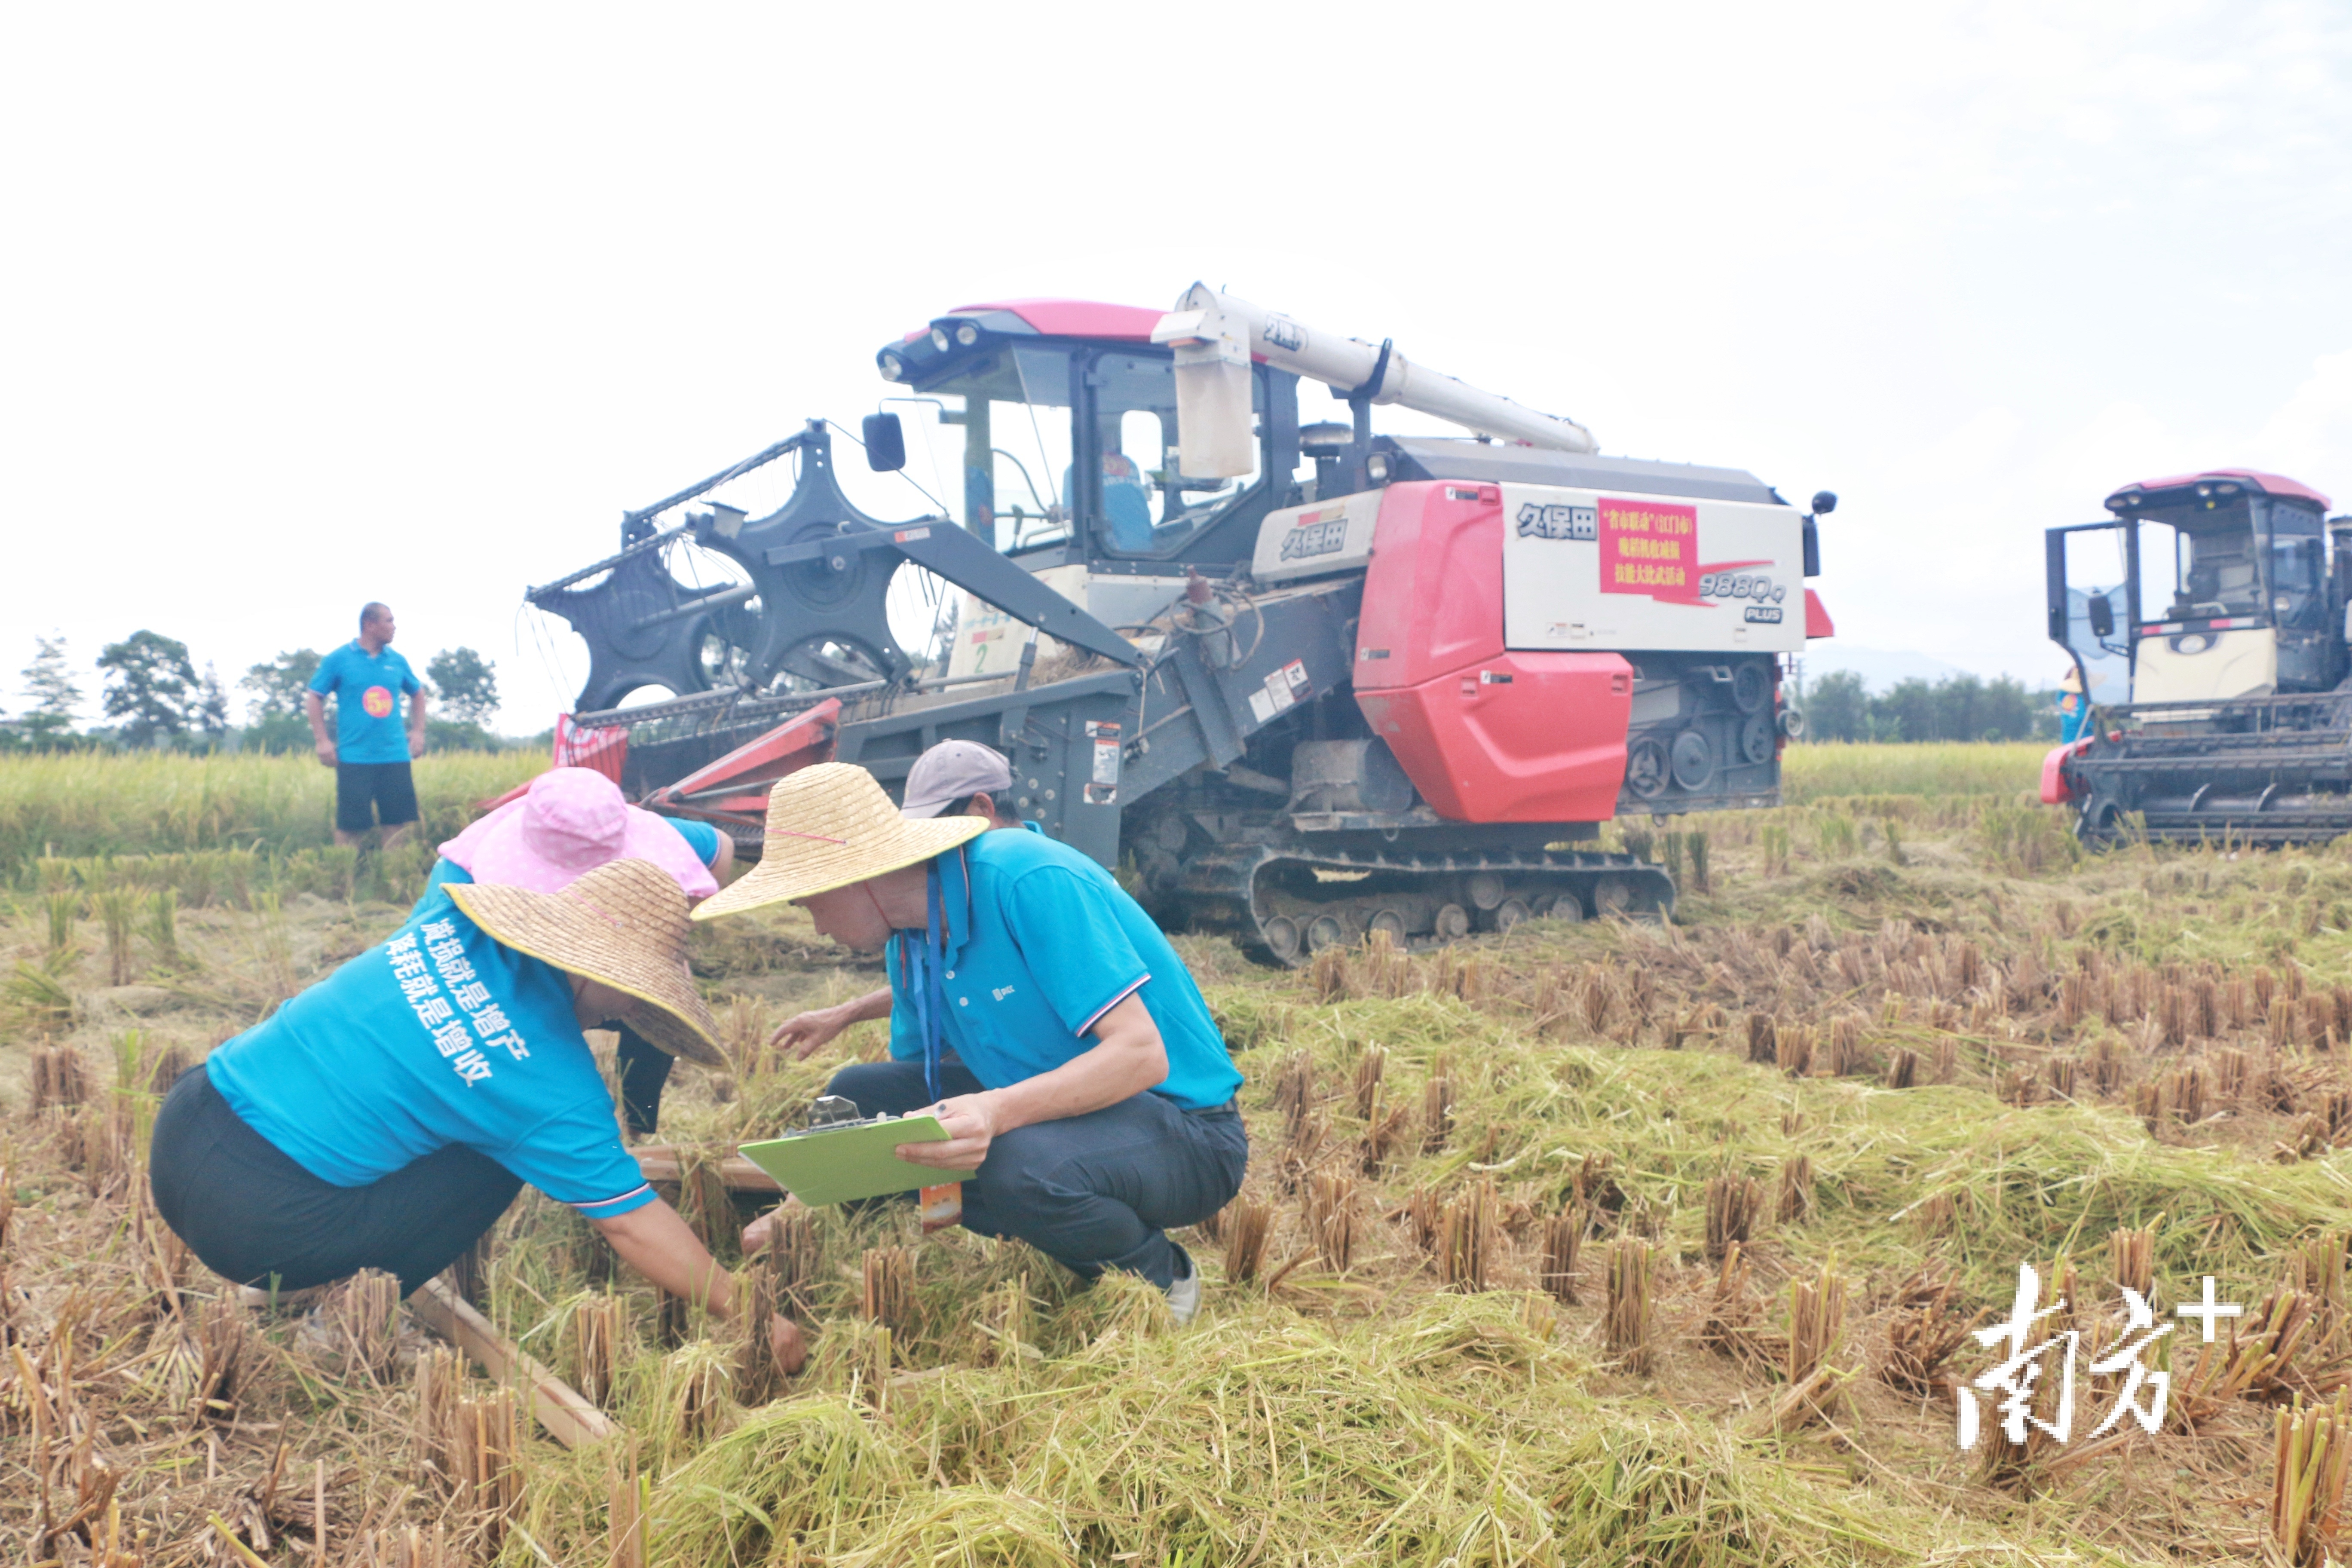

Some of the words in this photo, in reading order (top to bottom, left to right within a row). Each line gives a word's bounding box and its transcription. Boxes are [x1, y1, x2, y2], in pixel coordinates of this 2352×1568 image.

[1280, 518, 1348, 561] 久保田
[1517, 503, 1597, 541] 久保田
[1746, 609, 1781, 620] PLUS
[975, 643, 988, 674] 2
[421, 917, 530, 1060] 减损就是增产
[386, 932, 493, 1087] 降耗就是增收
